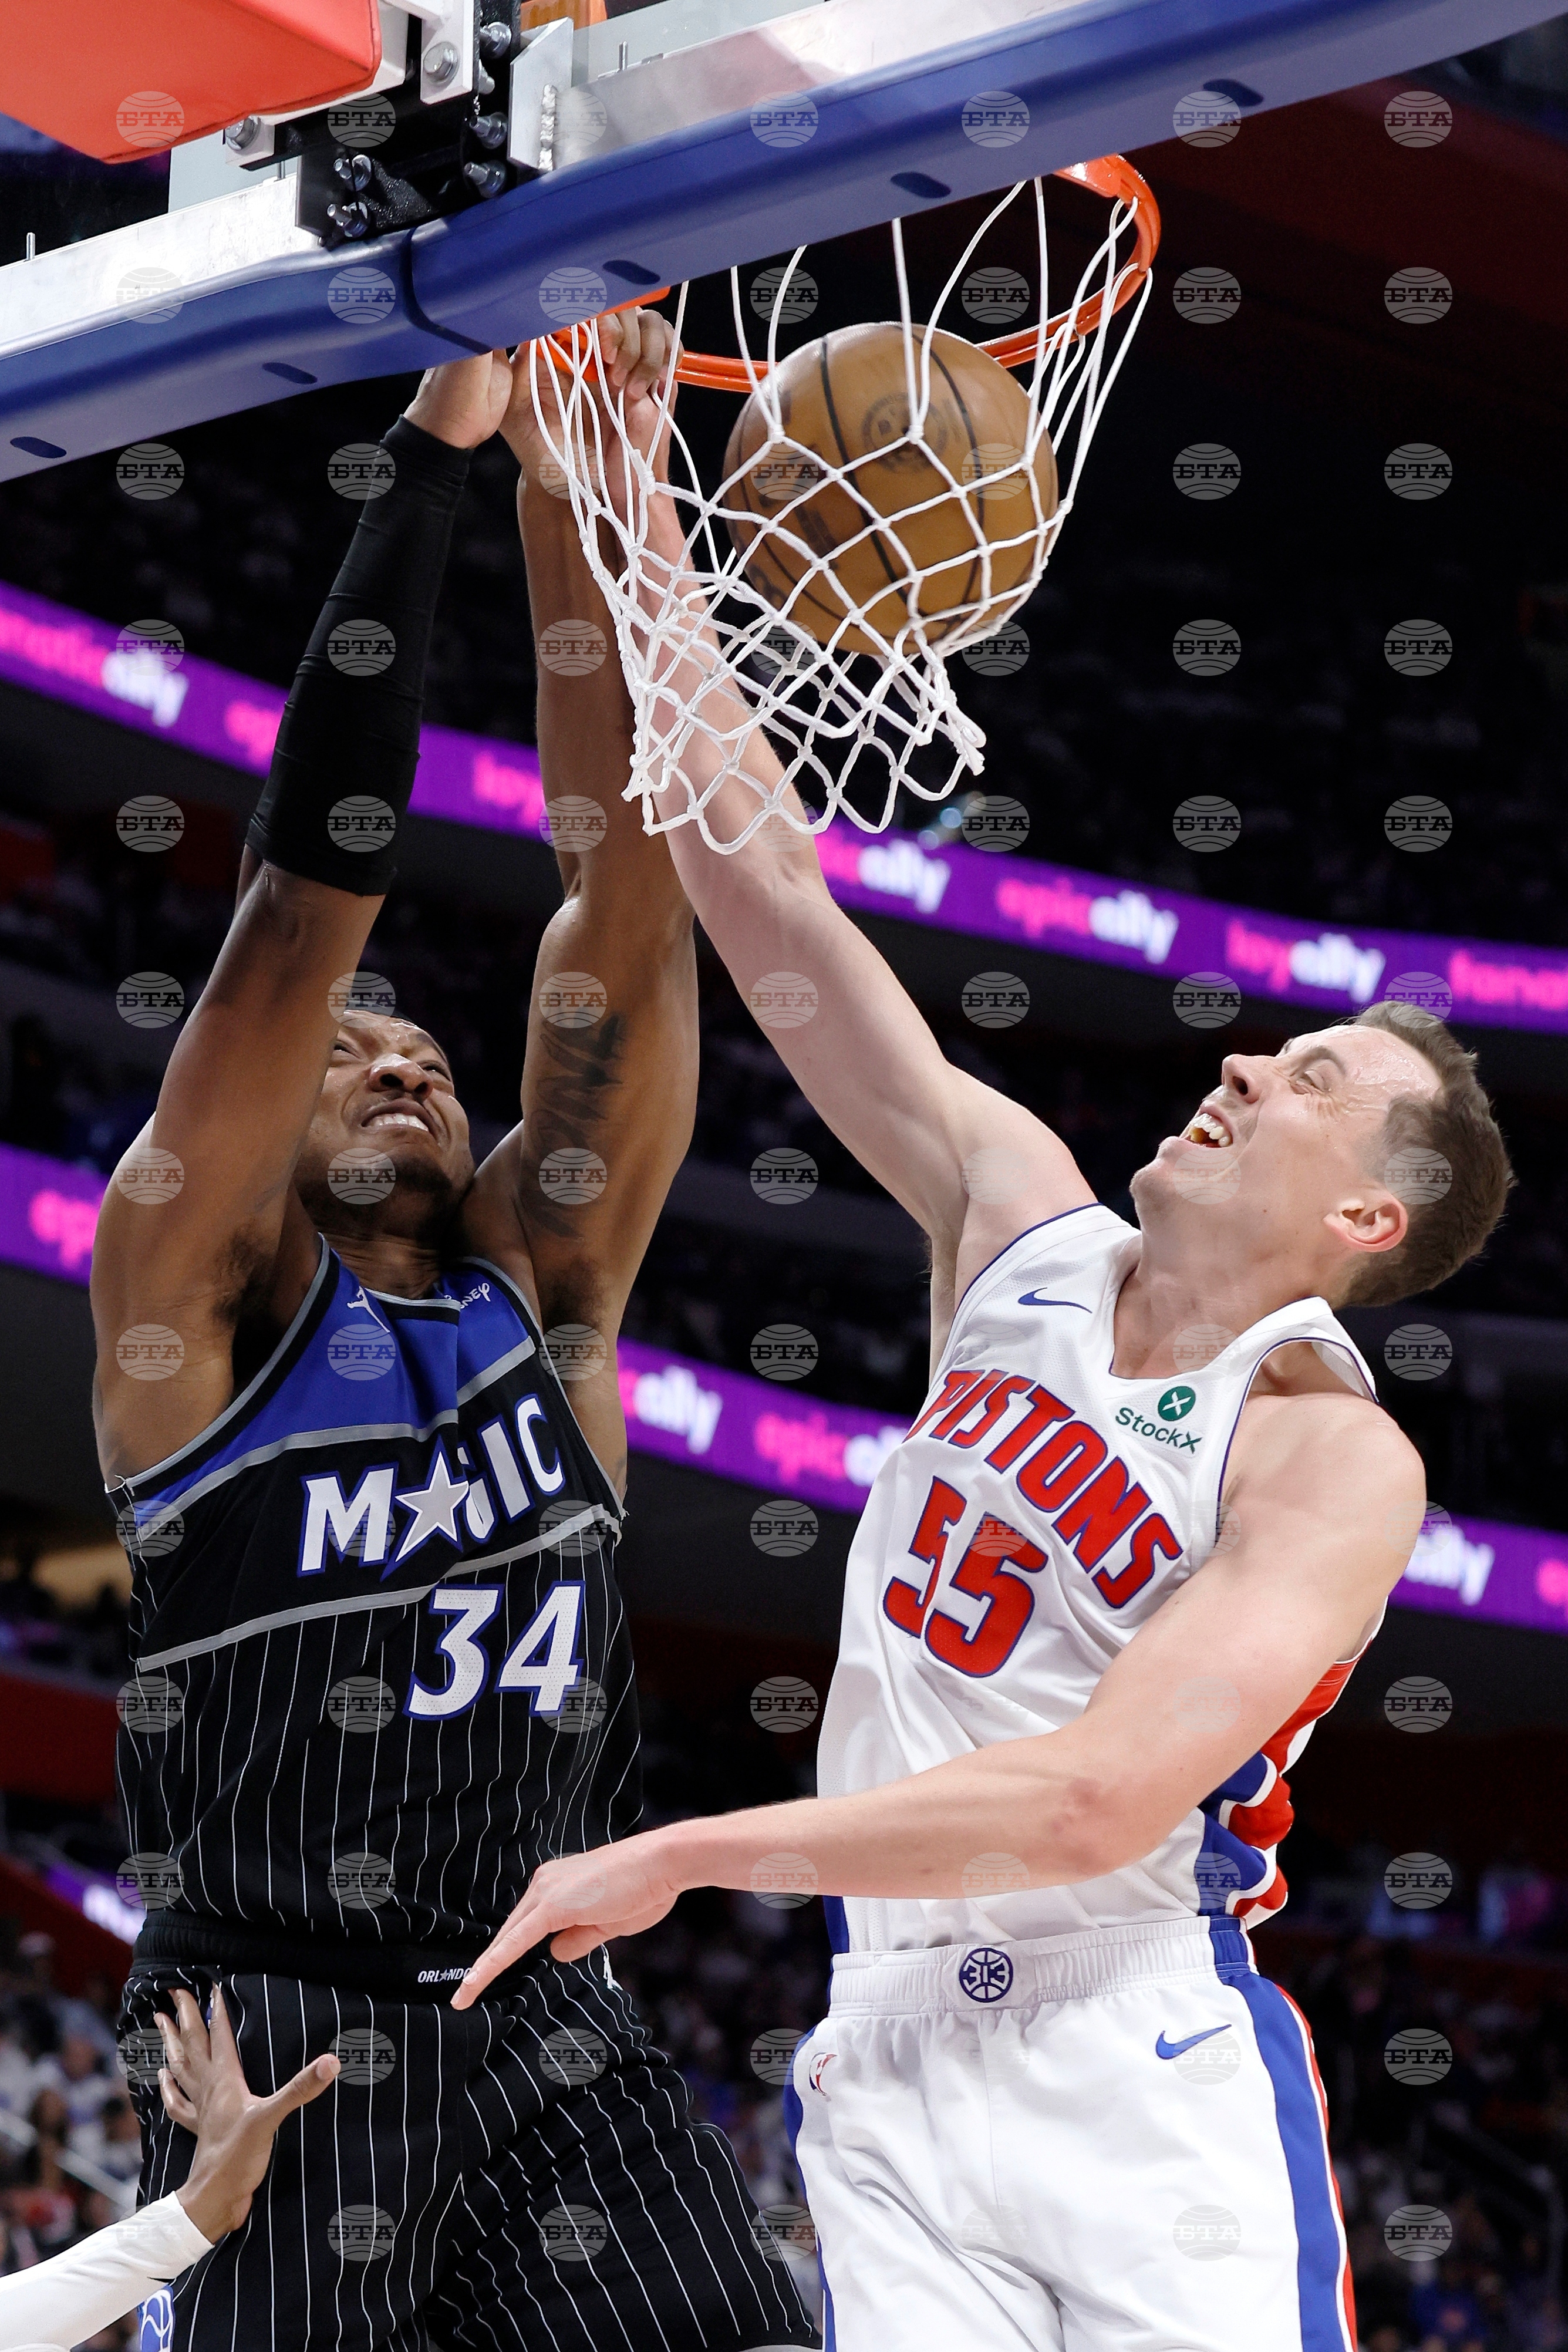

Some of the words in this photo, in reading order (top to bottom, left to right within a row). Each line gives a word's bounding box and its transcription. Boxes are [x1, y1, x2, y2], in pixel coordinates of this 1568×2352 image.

[902, 1369, 1183, 1609] PISTONS
[1115, 1407, 1203, 1454] StockX
[403, 1581, 586, 1721] 34
[882, 1475, 1049, 1679] 55
